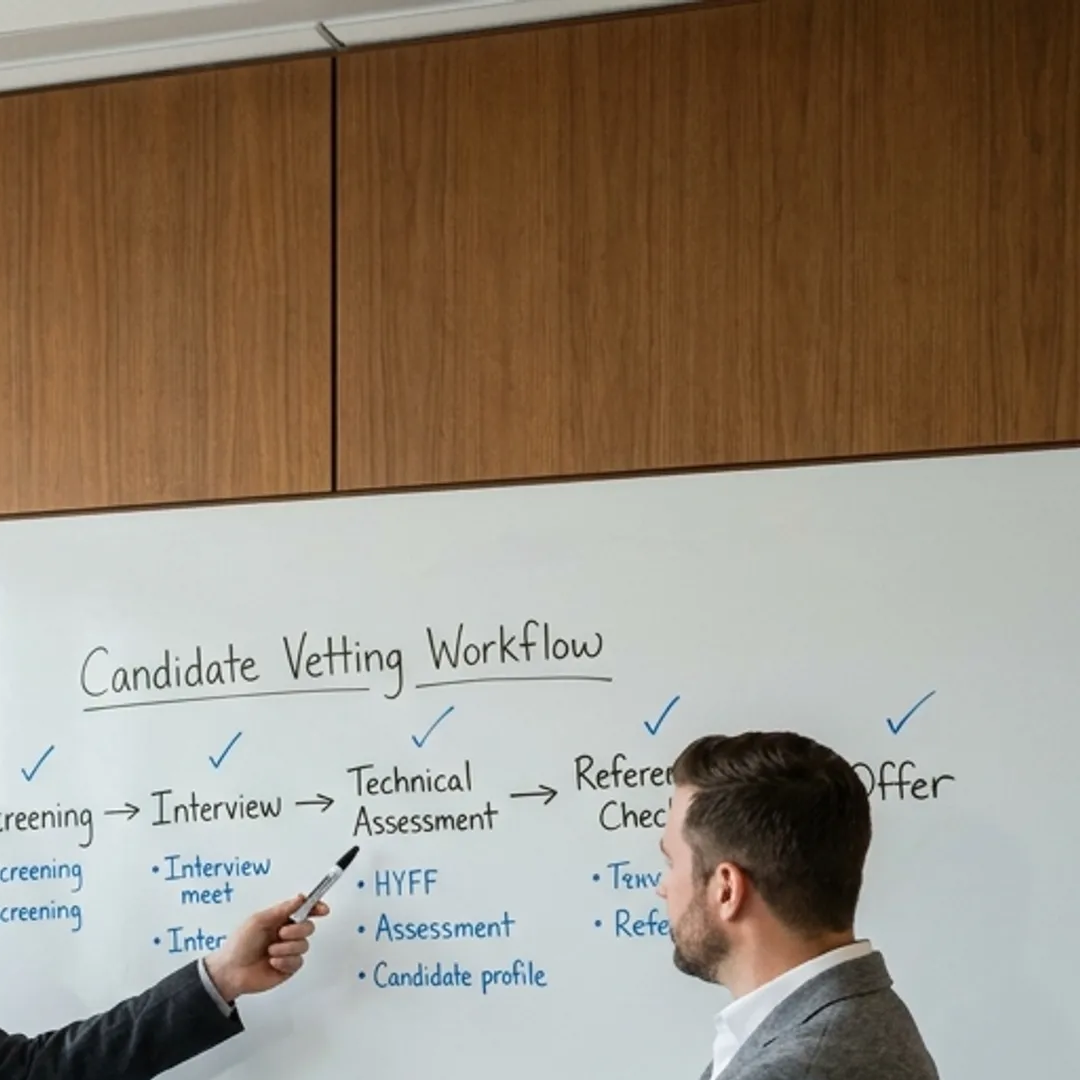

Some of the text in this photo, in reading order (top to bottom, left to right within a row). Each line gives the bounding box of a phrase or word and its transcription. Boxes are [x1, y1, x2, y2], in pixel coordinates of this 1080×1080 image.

[81, 618, 605, 701] Candidate Vetting Workflow
[345, 759, 472, 797] Technical
[149, 788, 282, 827] Interview
[352, 800, 500, 837] Assessment
[598, 796, 672, 832] Chec
[163, 853, 272, 882] Interview
[374, 868, 439, 897] HYFF
[180, 881, 235, 905] meet
[374, 910, 517, 943] Assessment
[373, 958, 548, 996] Candidate profile
